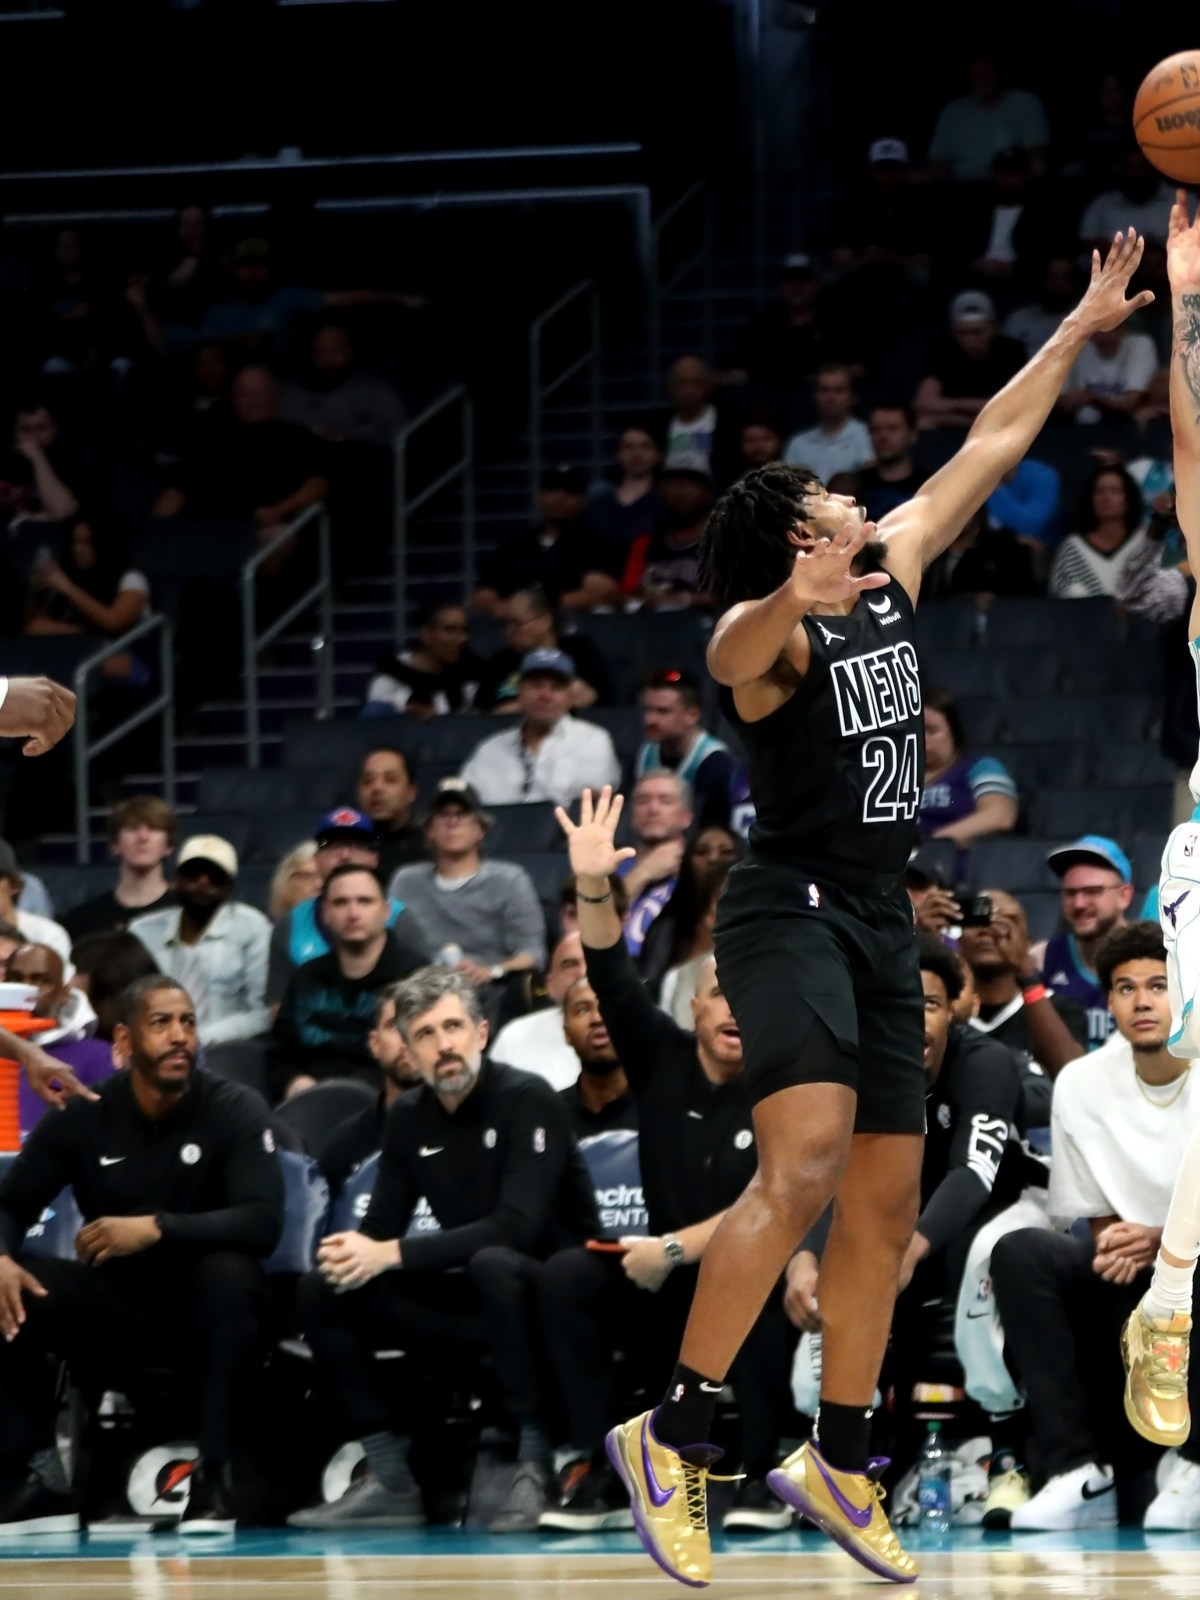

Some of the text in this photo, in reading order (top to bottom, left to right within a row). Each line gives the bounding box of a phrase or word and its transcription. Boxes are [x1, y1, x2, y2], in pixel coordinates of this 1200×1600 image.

[879, 611, 902, 626] Webull
[830, 641, 922, 737] NETS
[862, 734, 920, 823] 24
